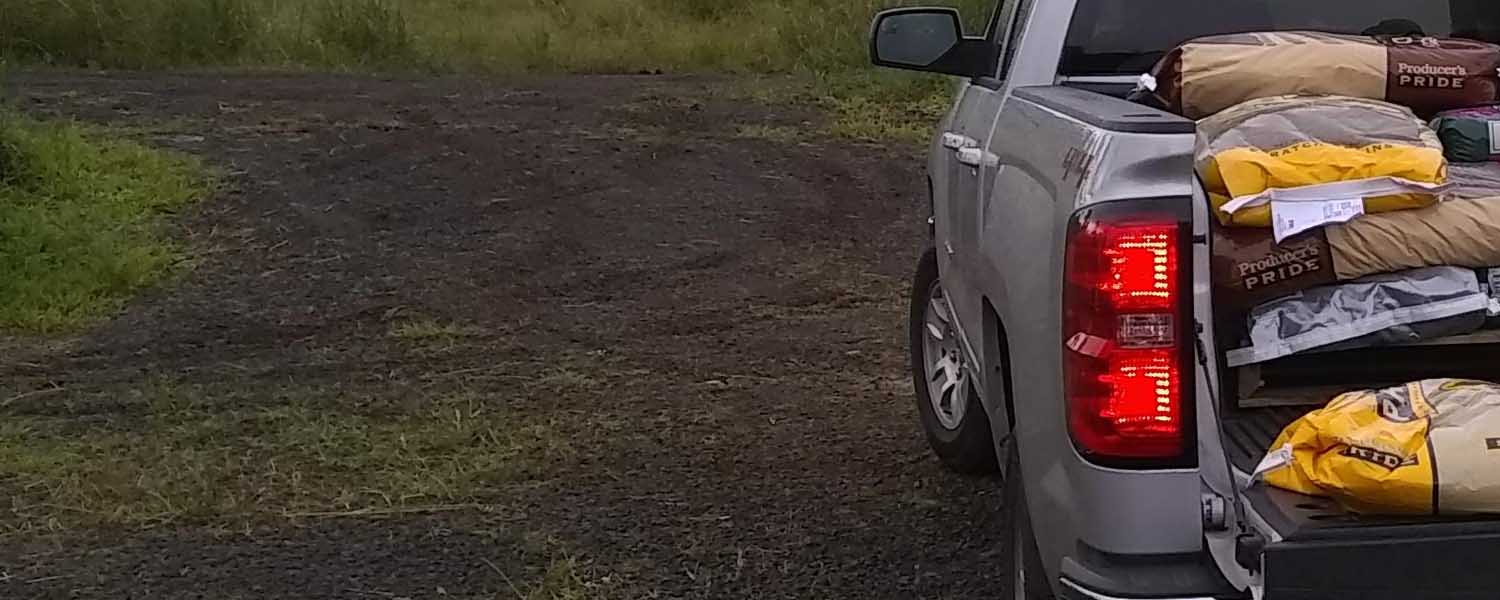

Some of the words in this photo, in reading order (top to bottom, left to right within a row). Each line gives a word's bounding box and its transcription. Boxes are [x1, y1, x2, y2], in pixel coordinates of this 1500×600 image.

[1398, 62, 1466, 76] Producer's
[1400, 75, 1464, 88] PRIDE
[1238, 242, 1319, 277] Producer's
[1244, 259, 1320, 290] PRIDE
